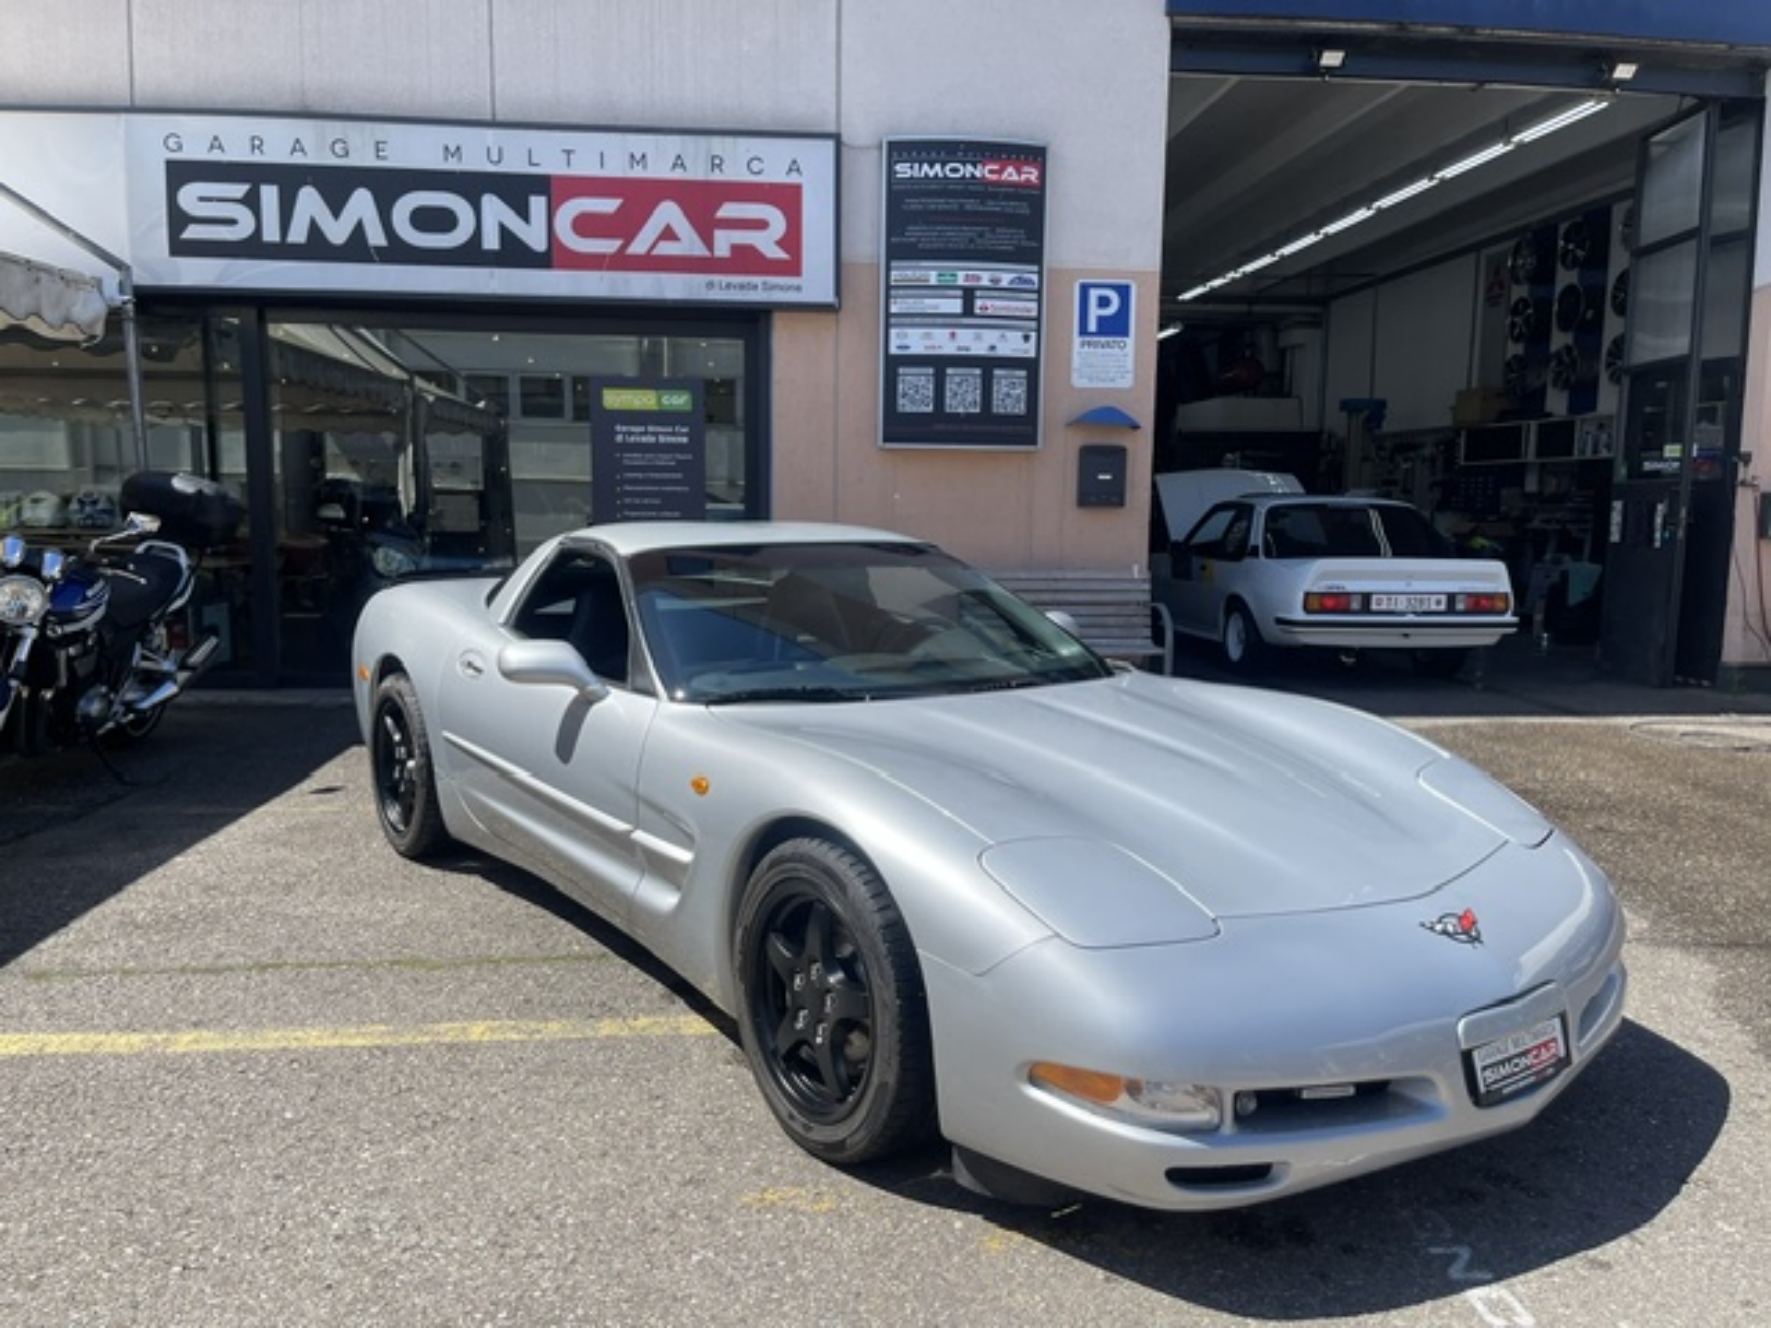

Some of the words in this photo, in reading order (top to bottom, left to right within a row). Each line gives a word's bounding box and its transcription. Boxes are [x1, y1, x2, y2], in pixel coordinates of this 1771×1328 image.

[163, 132, 390, 162] GARAGE
[443, 142, 804, 176] MULTIMARCA
[894, 162, 1039, 183] SIMONCAR
[176, 182, 790, 260] SIMONCAR
[705, 279, 715, 291] di
[718, 279, 759, 292] Levada
[761, 280, 803, 294] Simone
[1087, 287, 1120, 332] P
[1080, 340, 1127, 350] PRIVATO
